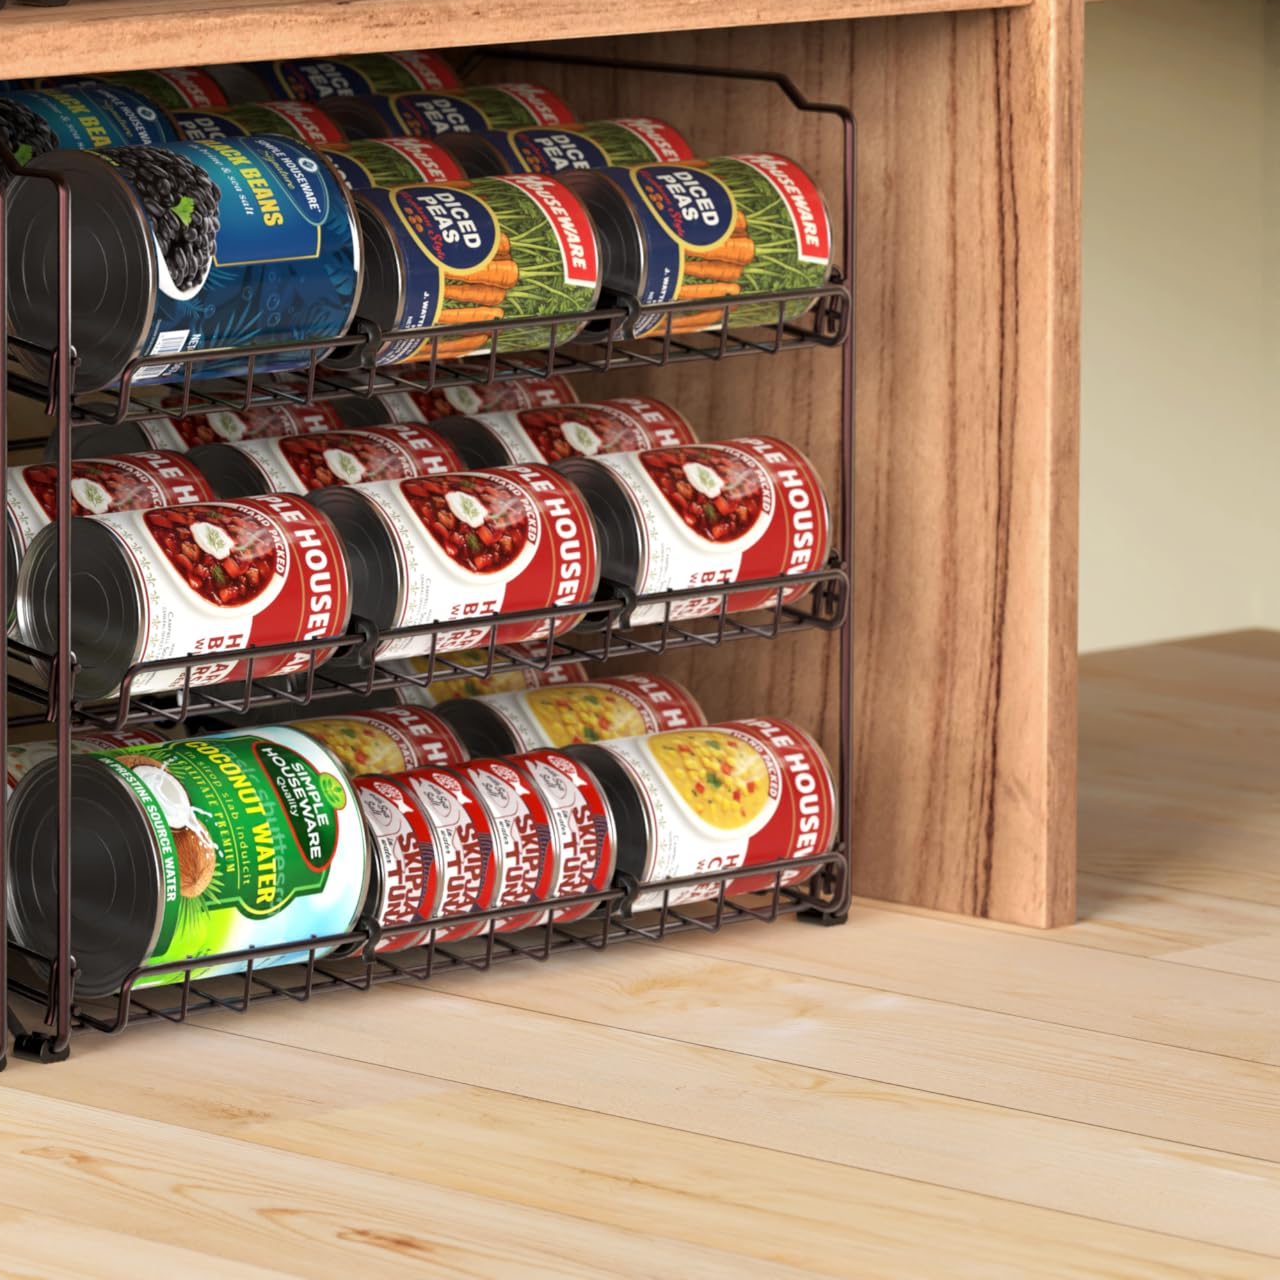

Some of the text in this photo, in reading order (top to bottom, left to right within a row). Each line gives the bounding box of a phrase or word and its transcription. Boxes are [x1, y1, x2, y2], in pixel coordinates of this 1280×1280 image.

[227, 172, 255, 215] sea salt
[241, 168, 285, 227] BEANS
[258, 139, 320, 211] SIMPLE HOUSEWARE
[656, 174, 699, 221] PEAS
[672, 171, 719, 226] DICED
[417, 196, 460, 244] PEAS
[435, 193, 482, 249] DICED
[521, 497, 537, 546] PACKED
[268, 527, 286, 578] PACKED
[261, 747, 322, 860] HOUSEWARE
[276, 776, 300, 817] Quality
[291, 762, 330, 827] SIMPLE
[762, 754, 778, 800] PACKED
[109, 762, 177, 902] PRESTINE SOURCE WATER
[185, 741, 266, 817] COCONUT
[252, 821, 277, 905] WATER
[222, 792, 239, 820] slab
